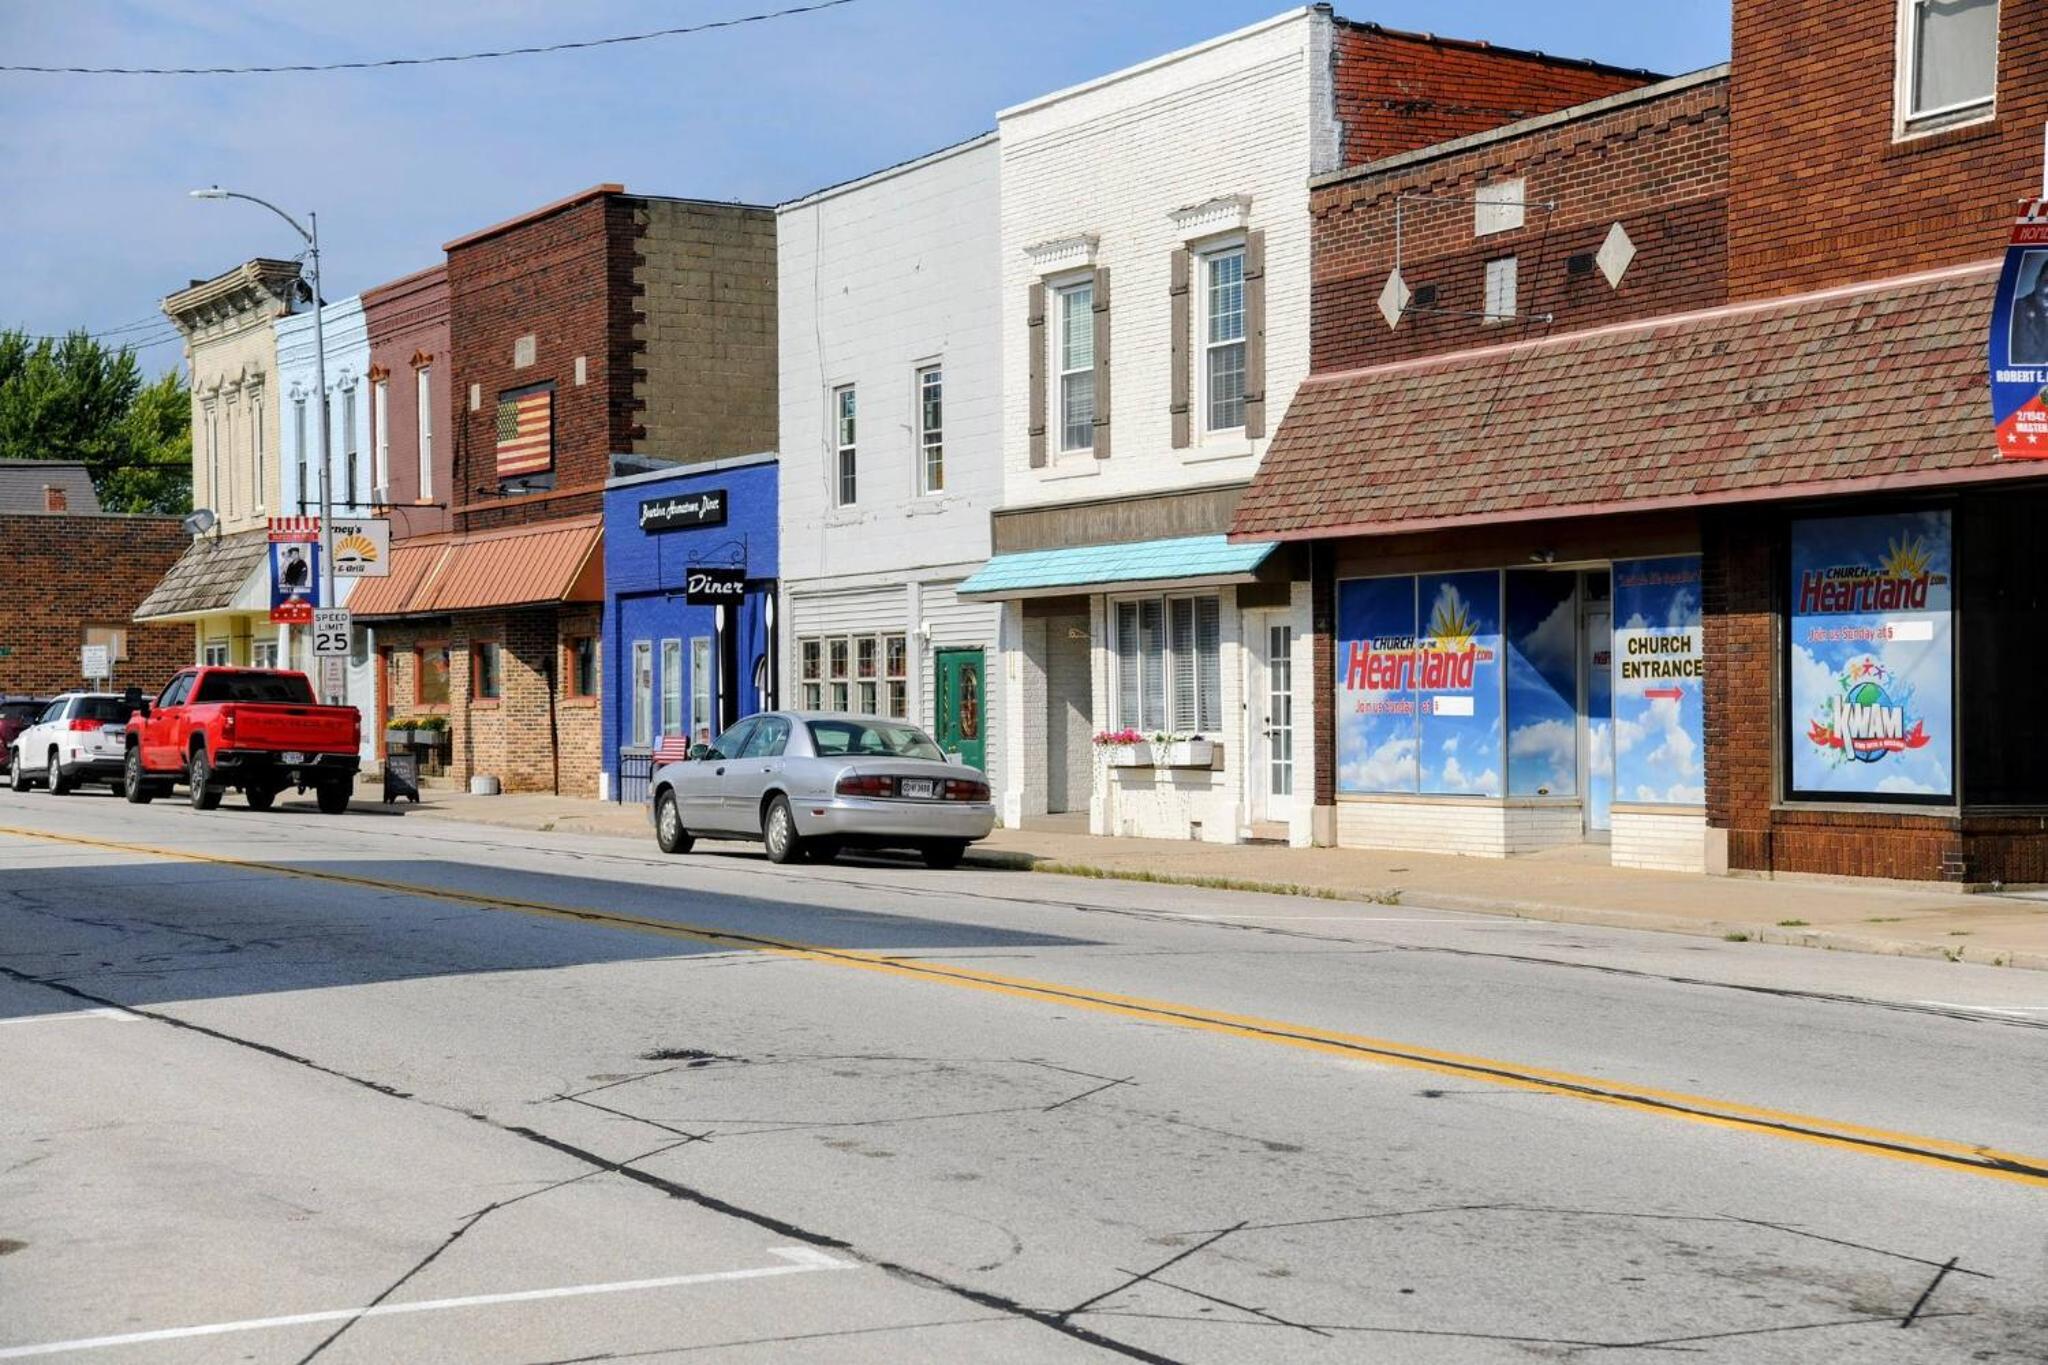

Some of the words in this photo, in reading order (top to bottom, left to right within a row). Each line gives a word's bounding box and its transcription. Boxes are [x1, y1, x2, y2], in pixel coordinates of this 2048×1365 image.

[1996, 370, 2035, 383] ROBERT
[1827, 566, 1868, 578] CHURCH
[688, 574, 744, 594] Diner
[1800, 569, 1929, 613] Heartland
[315, 613, 348, 622] SPEED
[319, 623, 344, 632] LIMIT
[1841, 627, 1874, 642] Sunday
[316, 633, 348, 651] 25
[1372, 636, 1415, 650] CHURCH
[1628, 636, 1691, 655] CHURCH
[1346, 640, 1476, 690] Heartland
[1621, 659, 1703, 679] ENTRANCE
[1834, 694, 1905, 761] KWAM
